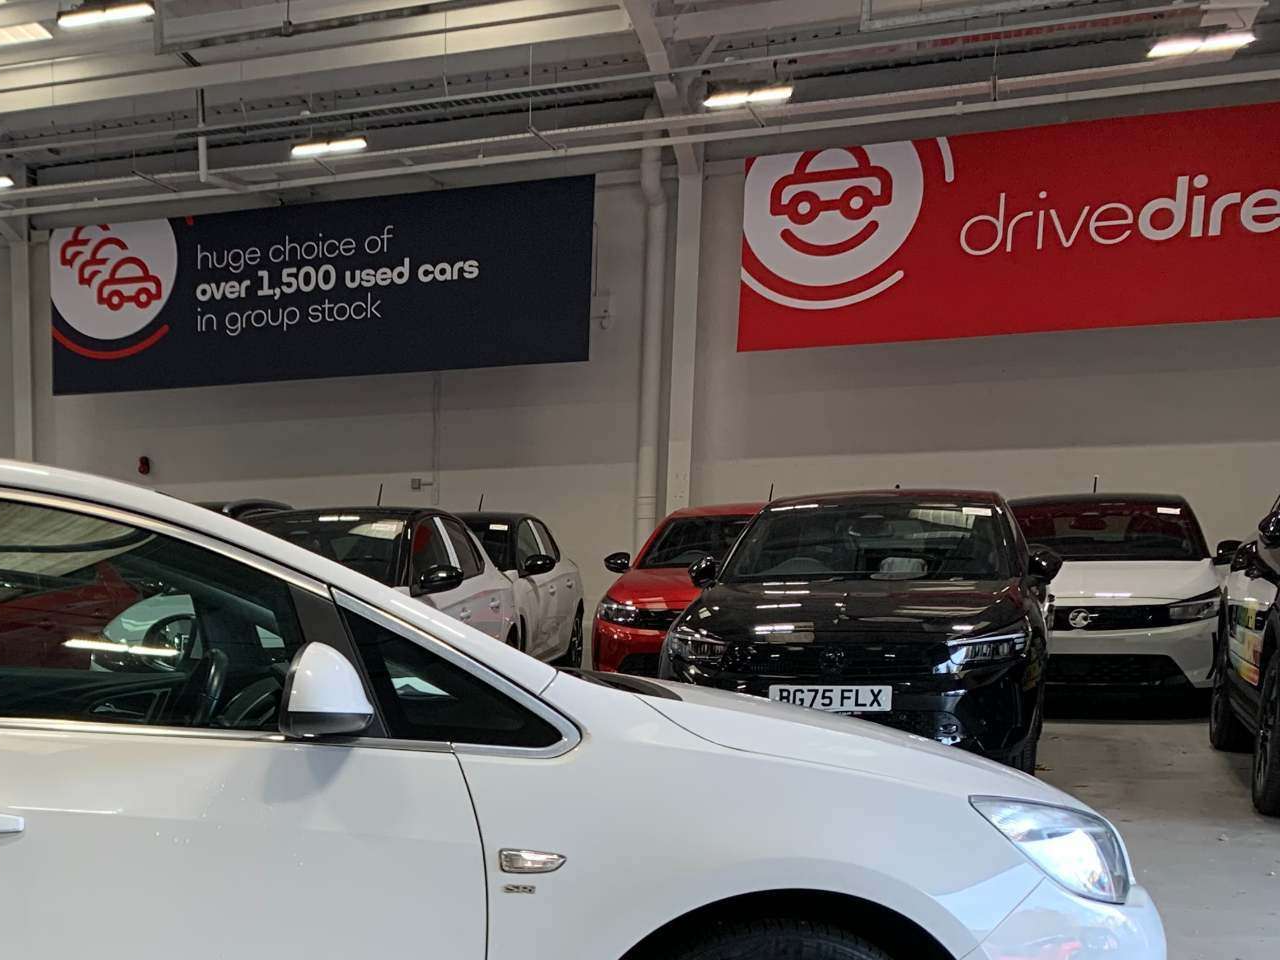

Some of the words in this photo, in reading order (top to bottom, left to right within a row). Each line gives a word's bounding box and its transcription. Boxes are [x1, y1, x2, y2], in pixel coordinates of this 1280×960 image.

[959, 174, 1280, 256] drivedire
[197, 244, 261, 273] huge
[269, 233, 356, 263] choice
[364, 225, 394, 254] of
[195, 279, 251, 301] over
[257, 264, 337, 300] 1,500
[344, 257, 410, 289] used
[417, 258, 480, 283] cars
[196, 307, 217, 332] in
[225, 306, 300, 336] group
[307, 292, 382, 322] stock
[779, 688, 834, 708] BG75
[839, 688, 883, 708] FLX
